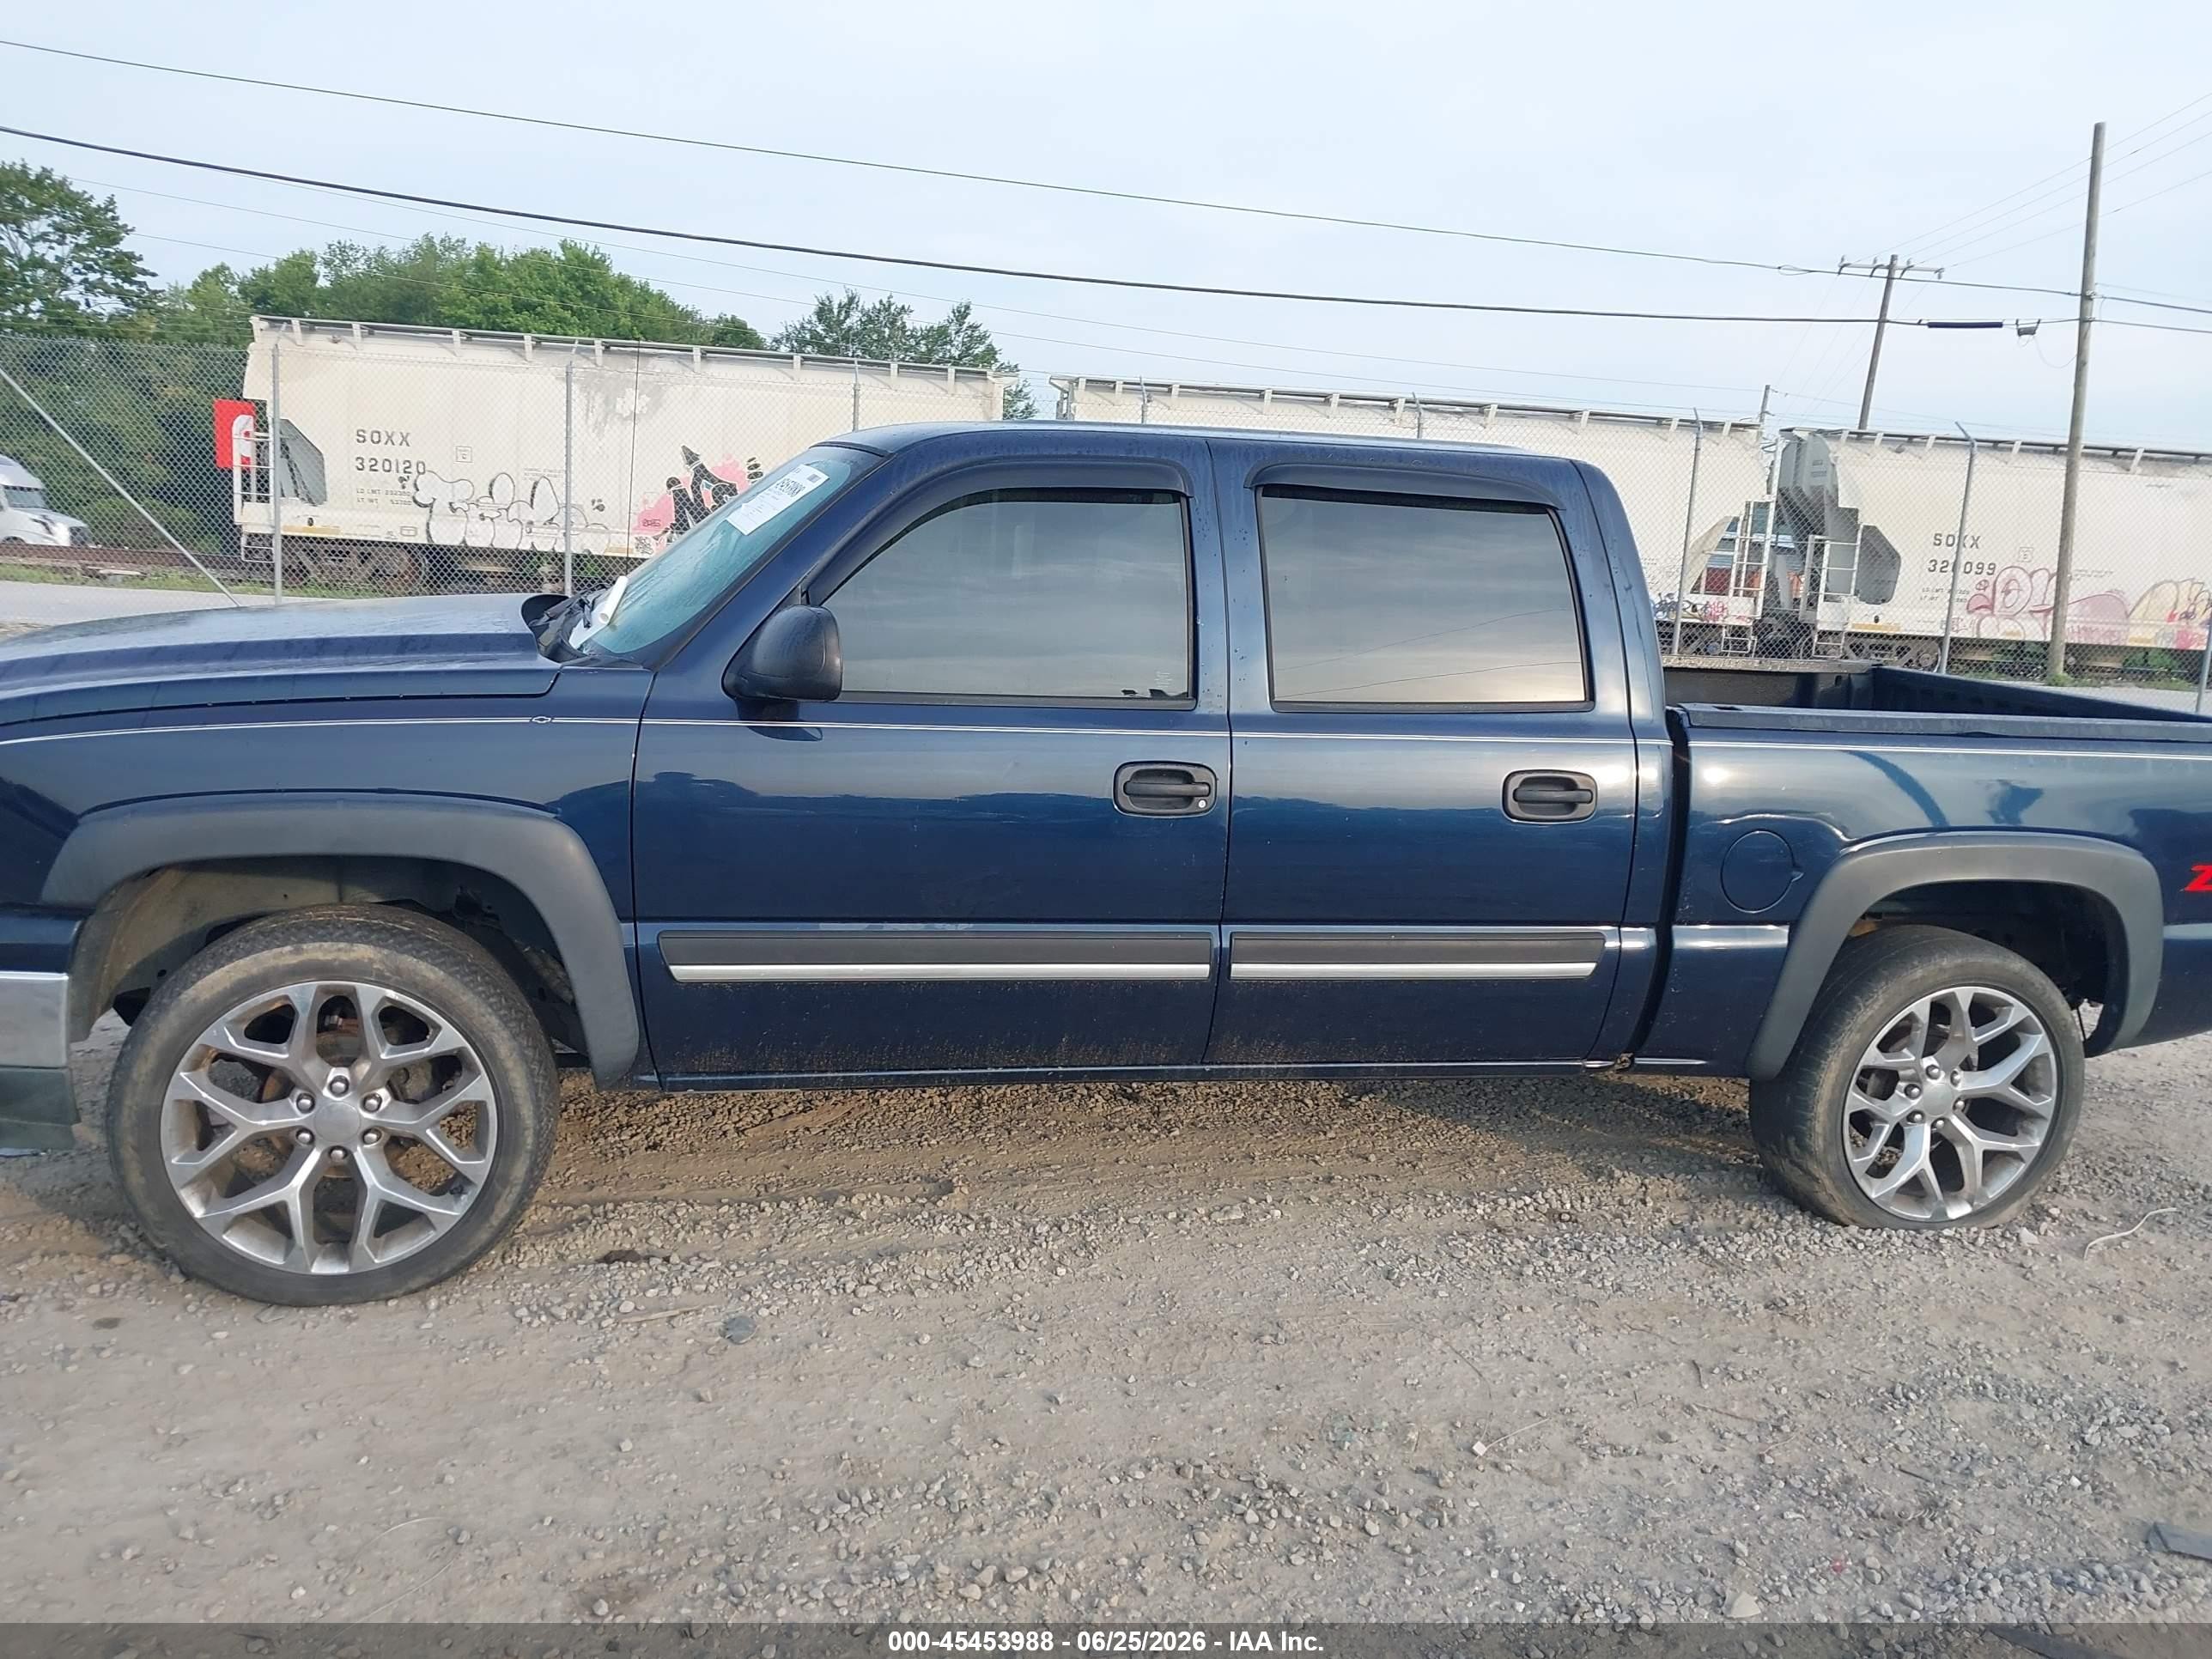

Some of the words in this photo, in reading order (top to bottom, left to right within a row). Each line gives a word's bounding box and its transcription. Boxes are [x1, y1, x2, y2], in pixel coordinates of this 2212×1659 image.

[356, 428, 410, 447] SOXX
[356, 456, 426, 475] 320120
[1927, 558, 1996, 576] 32099
